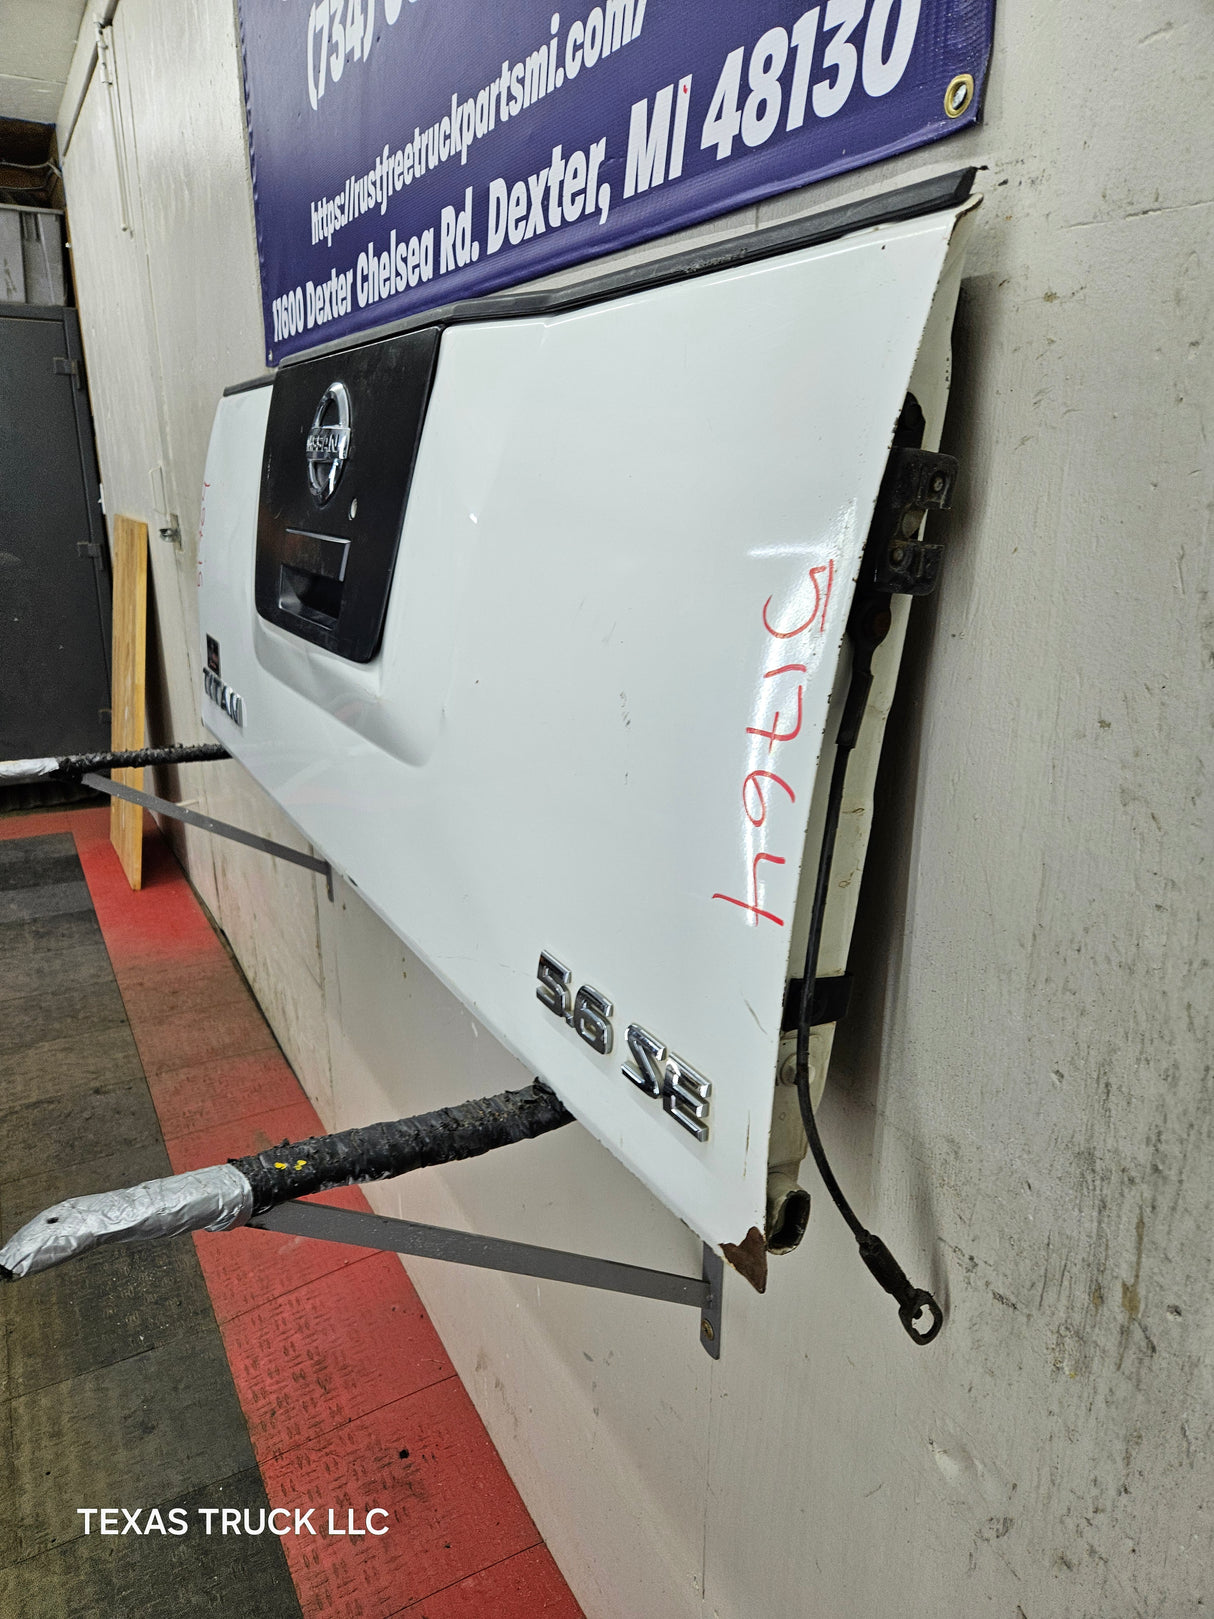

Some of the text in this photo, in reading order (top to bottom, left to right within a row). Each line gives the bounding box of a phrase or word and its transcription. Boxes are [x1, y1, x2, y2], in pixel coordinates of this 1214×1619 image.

[307, 0, 376, 110] (734)
[310, 0, 648, 247] https://rustfreetruckpartsmi.com/
[272, 0, 922, 343] 11600 Dexter Chelsea Rd. Dexter, MI 48130
[202, 666, 245, 729] TITAN
[536, 949, 712, 1142] 5.6 SE
